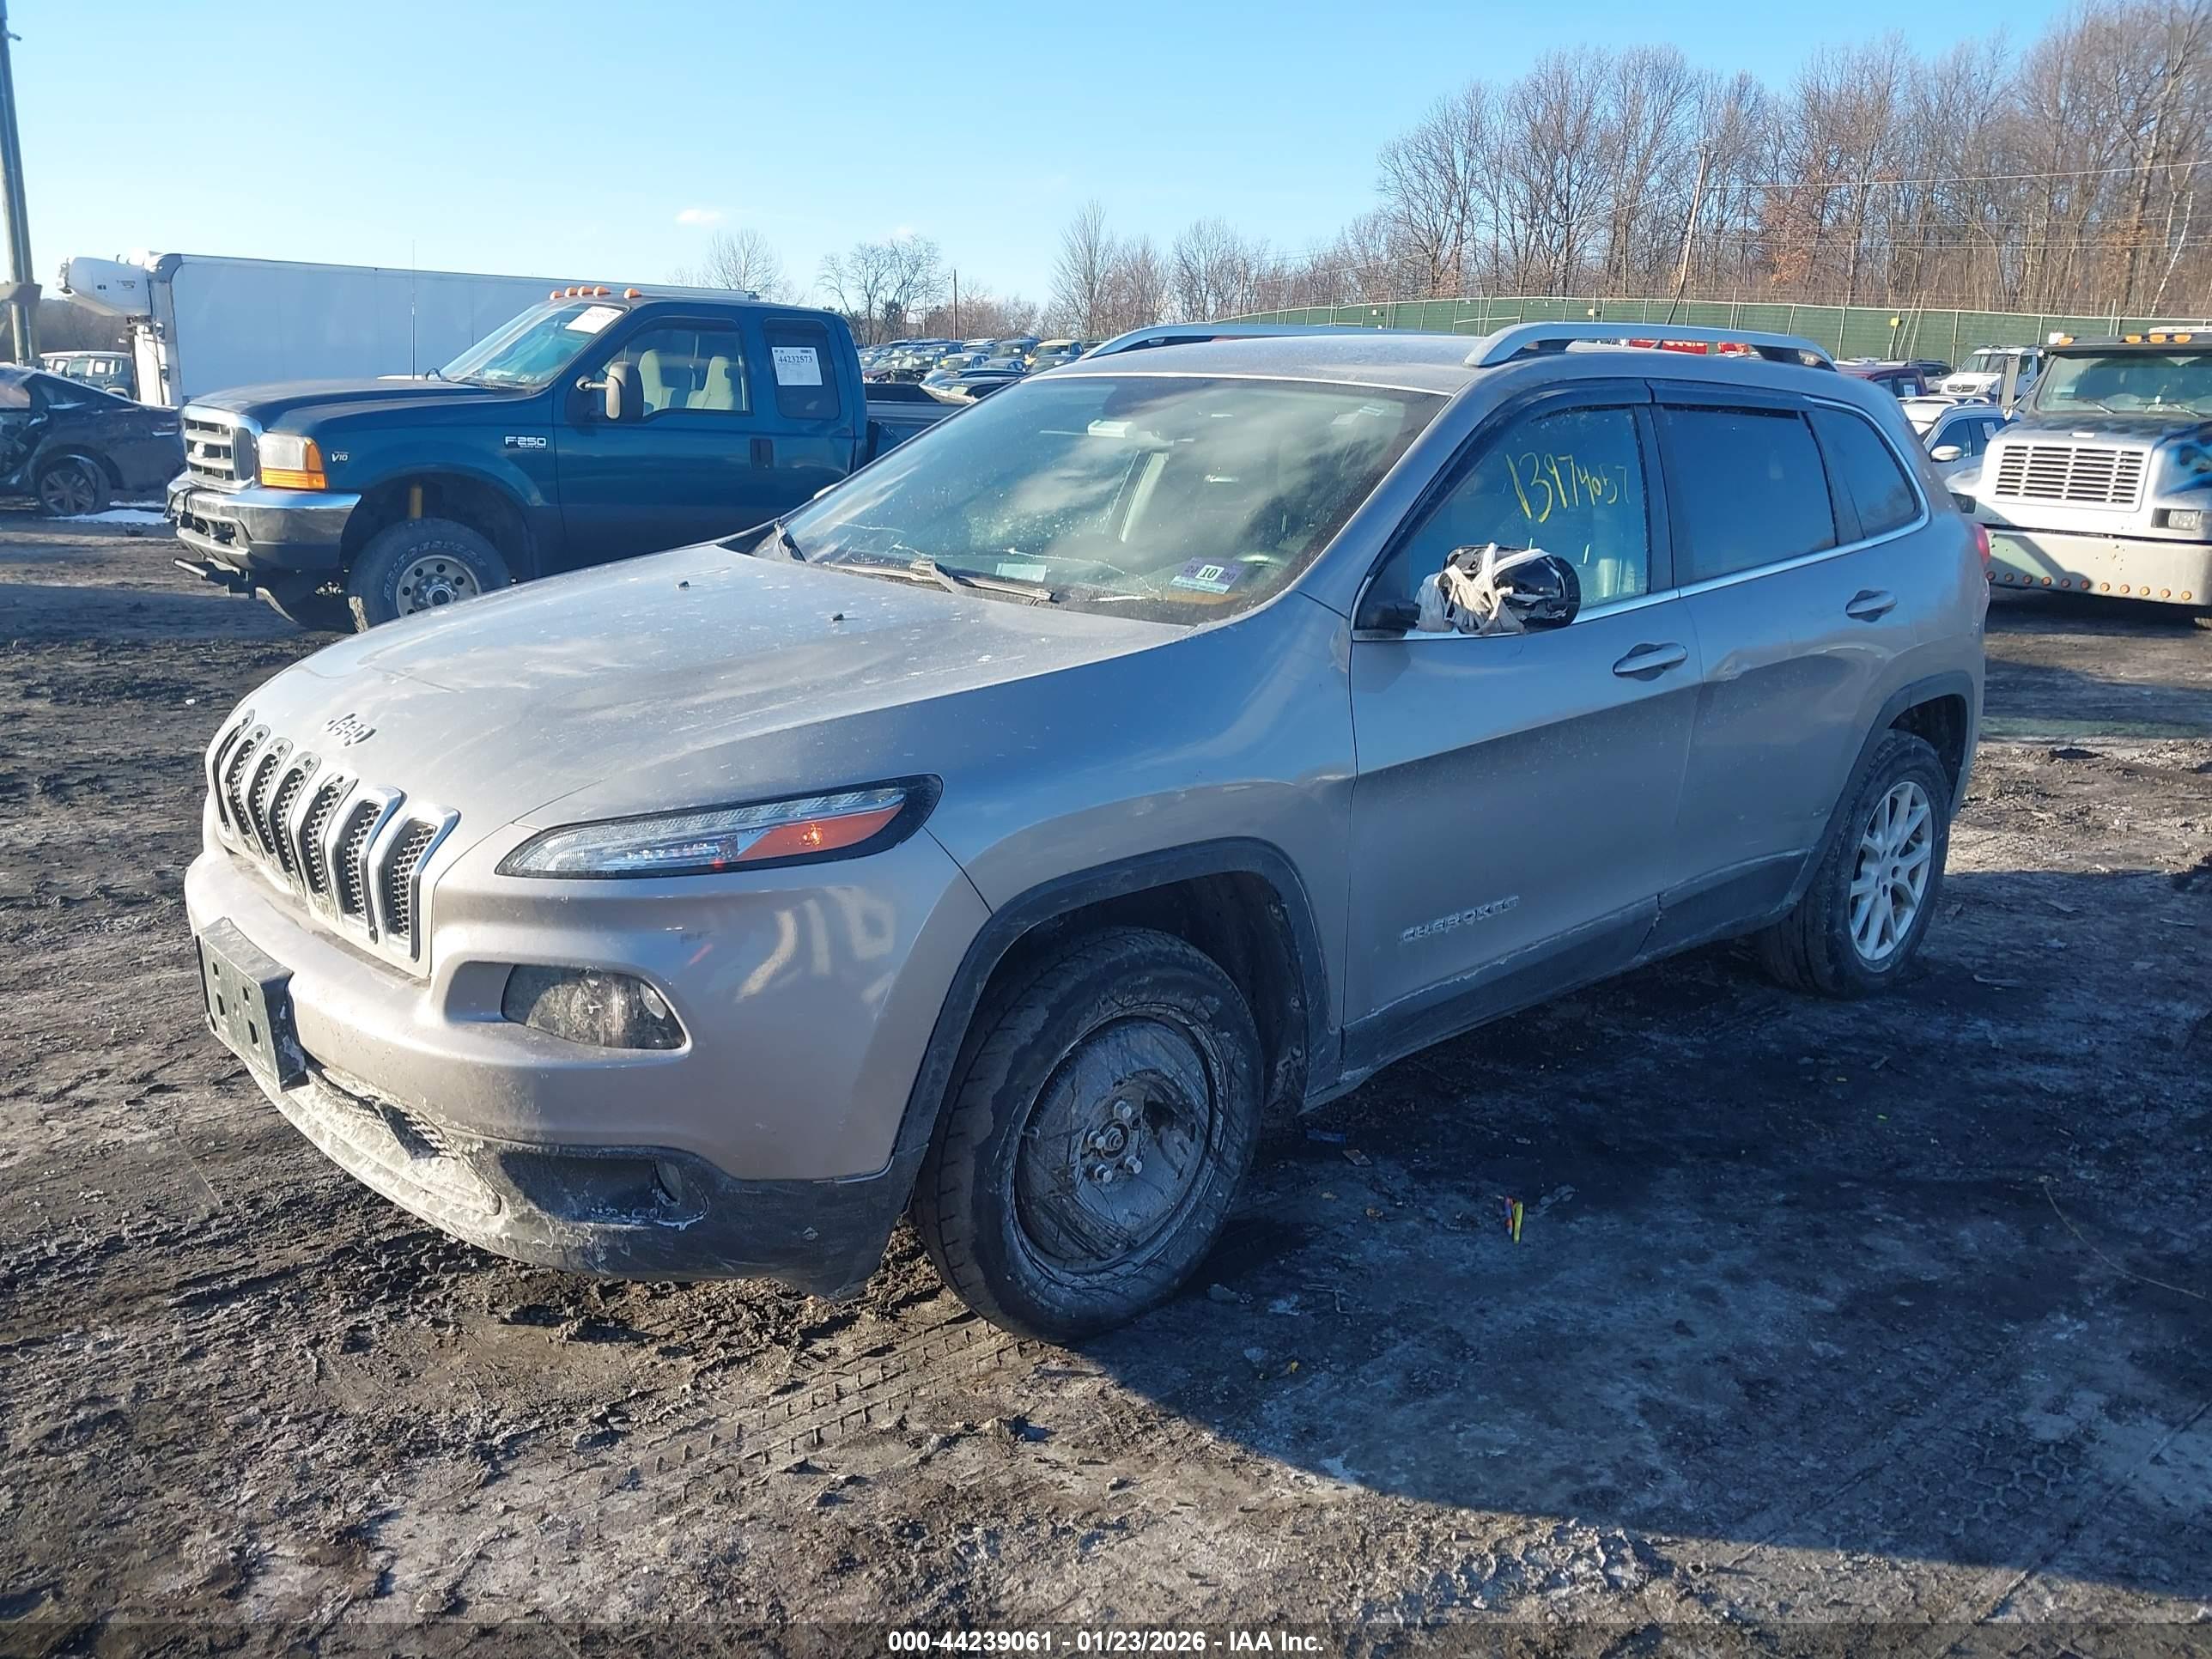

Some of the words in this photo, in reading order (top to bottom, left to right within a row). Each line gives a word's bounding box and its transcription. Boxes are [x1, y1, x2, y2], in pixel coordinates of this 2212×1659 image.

[505, 436, 546, 446] F-250
[331, 453, 349, 462] V10
[1200, 567, 1218, 579] 10
[323, 712, 377, 747] Jeep
